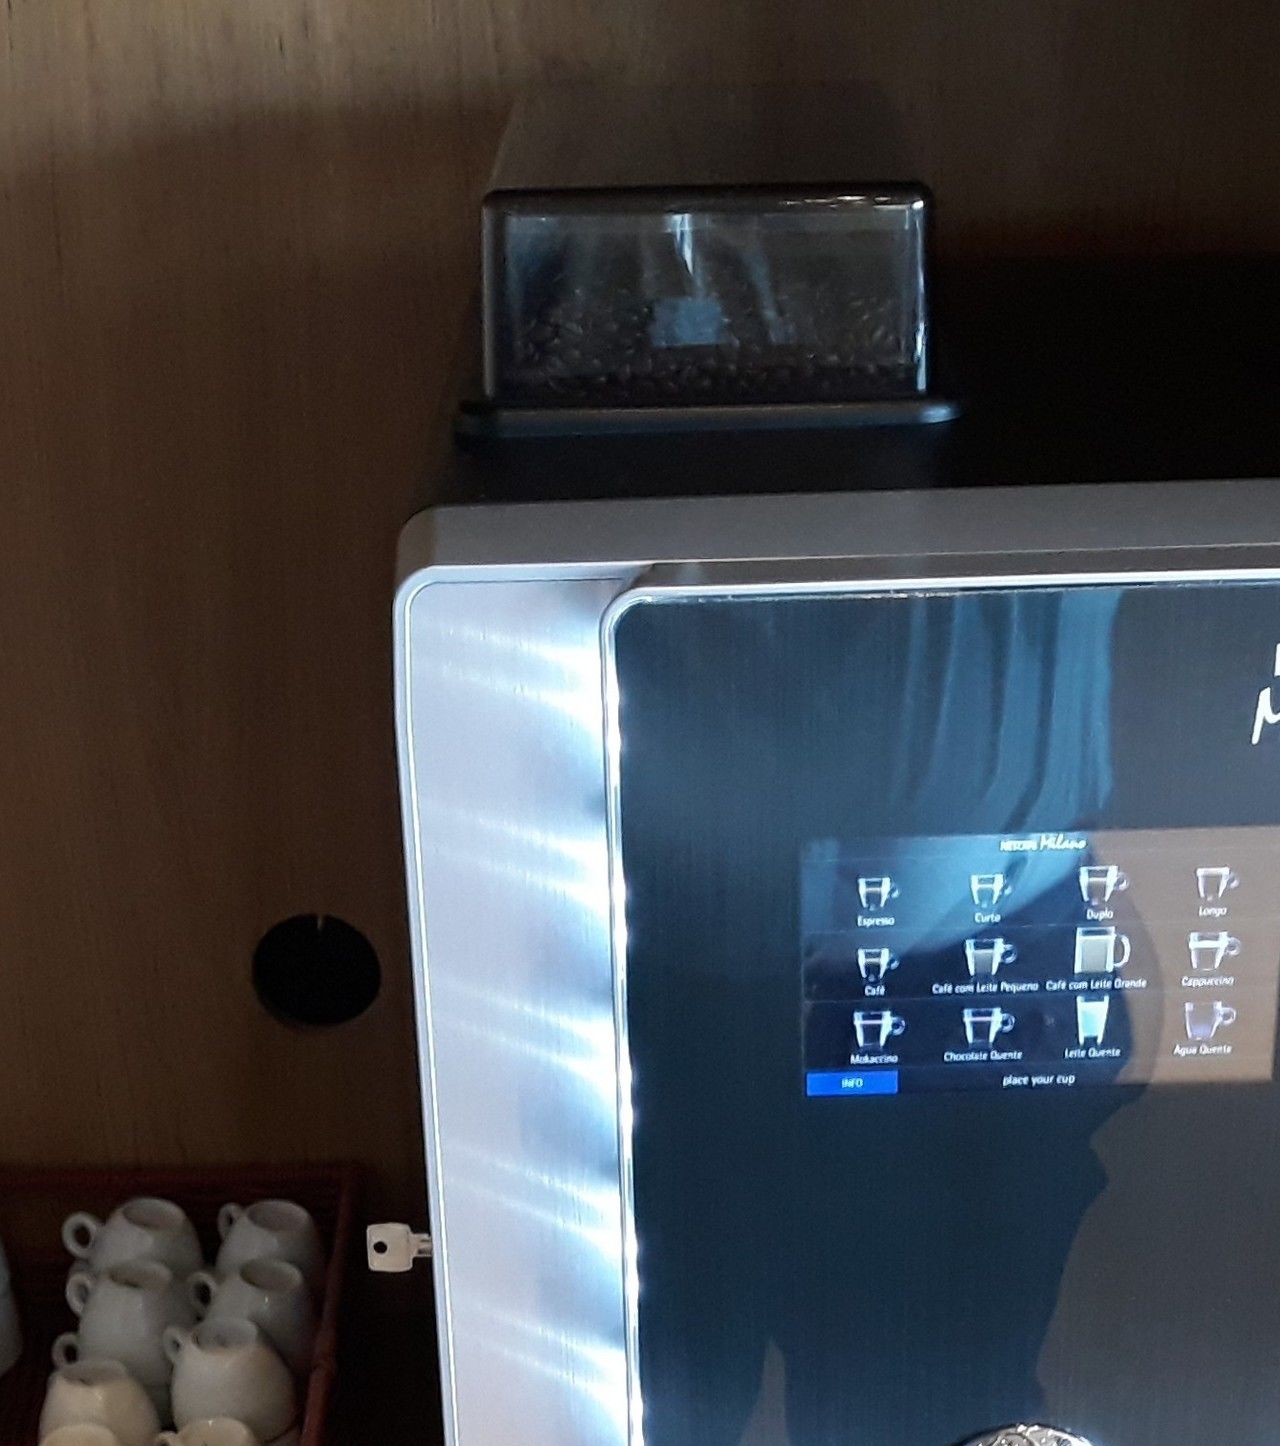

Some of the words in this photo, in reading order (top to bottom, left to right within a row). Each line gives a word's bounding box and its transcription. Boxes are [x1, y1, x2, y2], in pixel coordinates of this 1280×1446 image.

[1087, 908, 1114, 921] Duplo
[1199, 905, 1227, 917] Longo
[857, 915, 895, 926] Espresso
[975, 912, 1001, 923] Curto
[1000, 981, 1039, 993] Pequeno
[841, 1078, 863, 1088] INFO
[1003, 1075, 1028, 1088] place
[1031, 1075, 1054, 1087] your
[1056, 1074, 1076, 1086] cup
